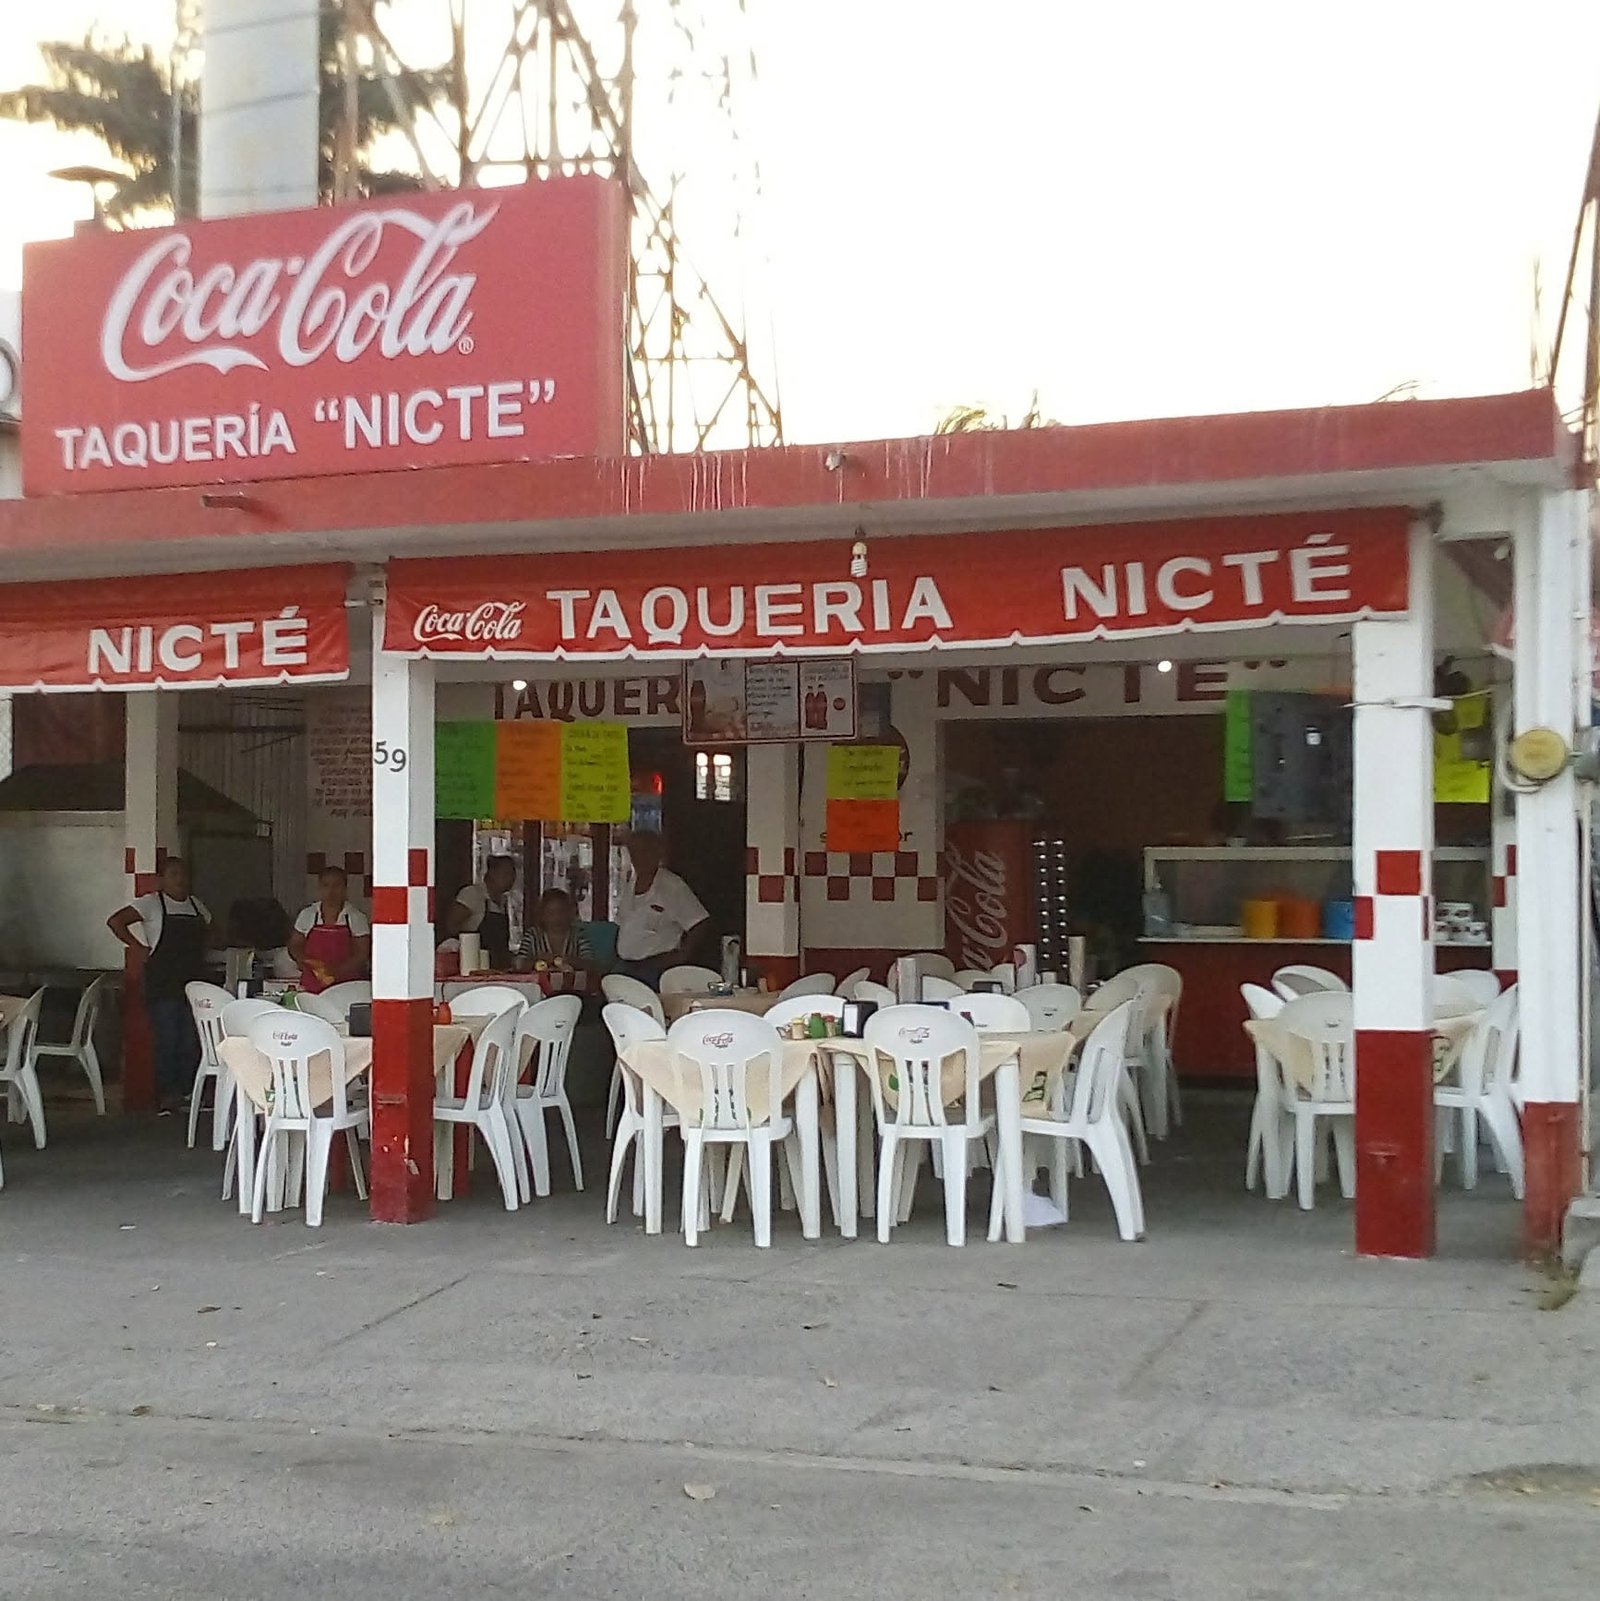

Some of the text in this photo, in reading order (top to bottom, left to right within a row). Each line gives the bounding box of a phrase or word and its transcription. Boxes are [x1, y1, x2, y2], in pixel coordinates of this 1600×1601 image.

[102, 201, 499, 381] Coca-Cola
[55, 404, 296, 469] TAQUERÍA
[413, 534, 1351, 644] Coca-Cola TAQUERIA NICTÉ
[88, 606, 308, 674] NICTÉ
[494, 677, 681, 722] TAQUER
[373, 740, 407, 772] 59
